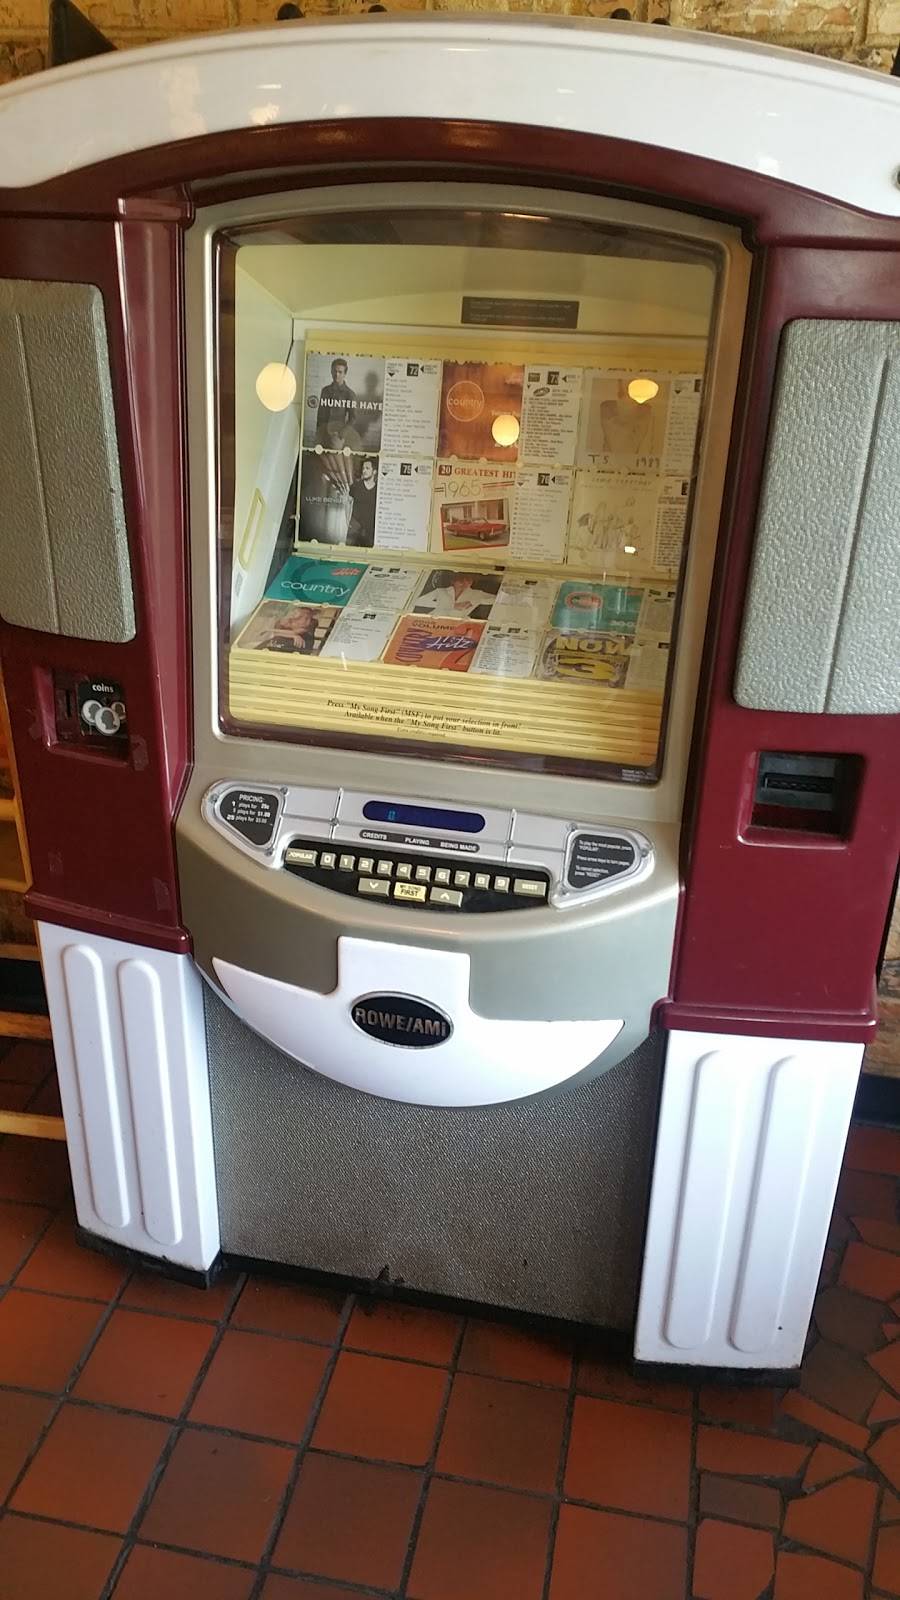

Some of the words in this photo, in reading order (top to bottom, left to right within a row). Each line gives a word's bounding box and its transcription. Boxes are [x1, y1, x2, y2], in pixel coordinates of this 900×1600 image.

[320, 398, 357, 408] HUNTER
[454, 468, 499, 477] GREATEST
[442, 480, 480, 497] 1965
[280, 580, 350, 597] country
[92, 683, 114, 692] coins
[328, 700, 344, 708] Press
[362, 704, 378, 713] Song
[462, 718, 490, 726] selection
[345, 711, 373, 720] Available
[423, 721, 438, 730] Song
[462, 726, 484, 734] button
[362, 831, 388, 841] CREDITS
[404, 837, 430, 846] PLAYING
[440, 842, 459, 850] BEING
[460, 843, 478, 851] MADE
[288, 852, 313, 860] POPULAR
[324, 855, 331, 863] 0
[361, 860, 369, 868] 2
[381, 863, 388, 871] 3
[400, 865, 408, 873] 4
[459, 874, 466, 882] 7
[354, 1008, 446, 1036] ROWE/AMI
